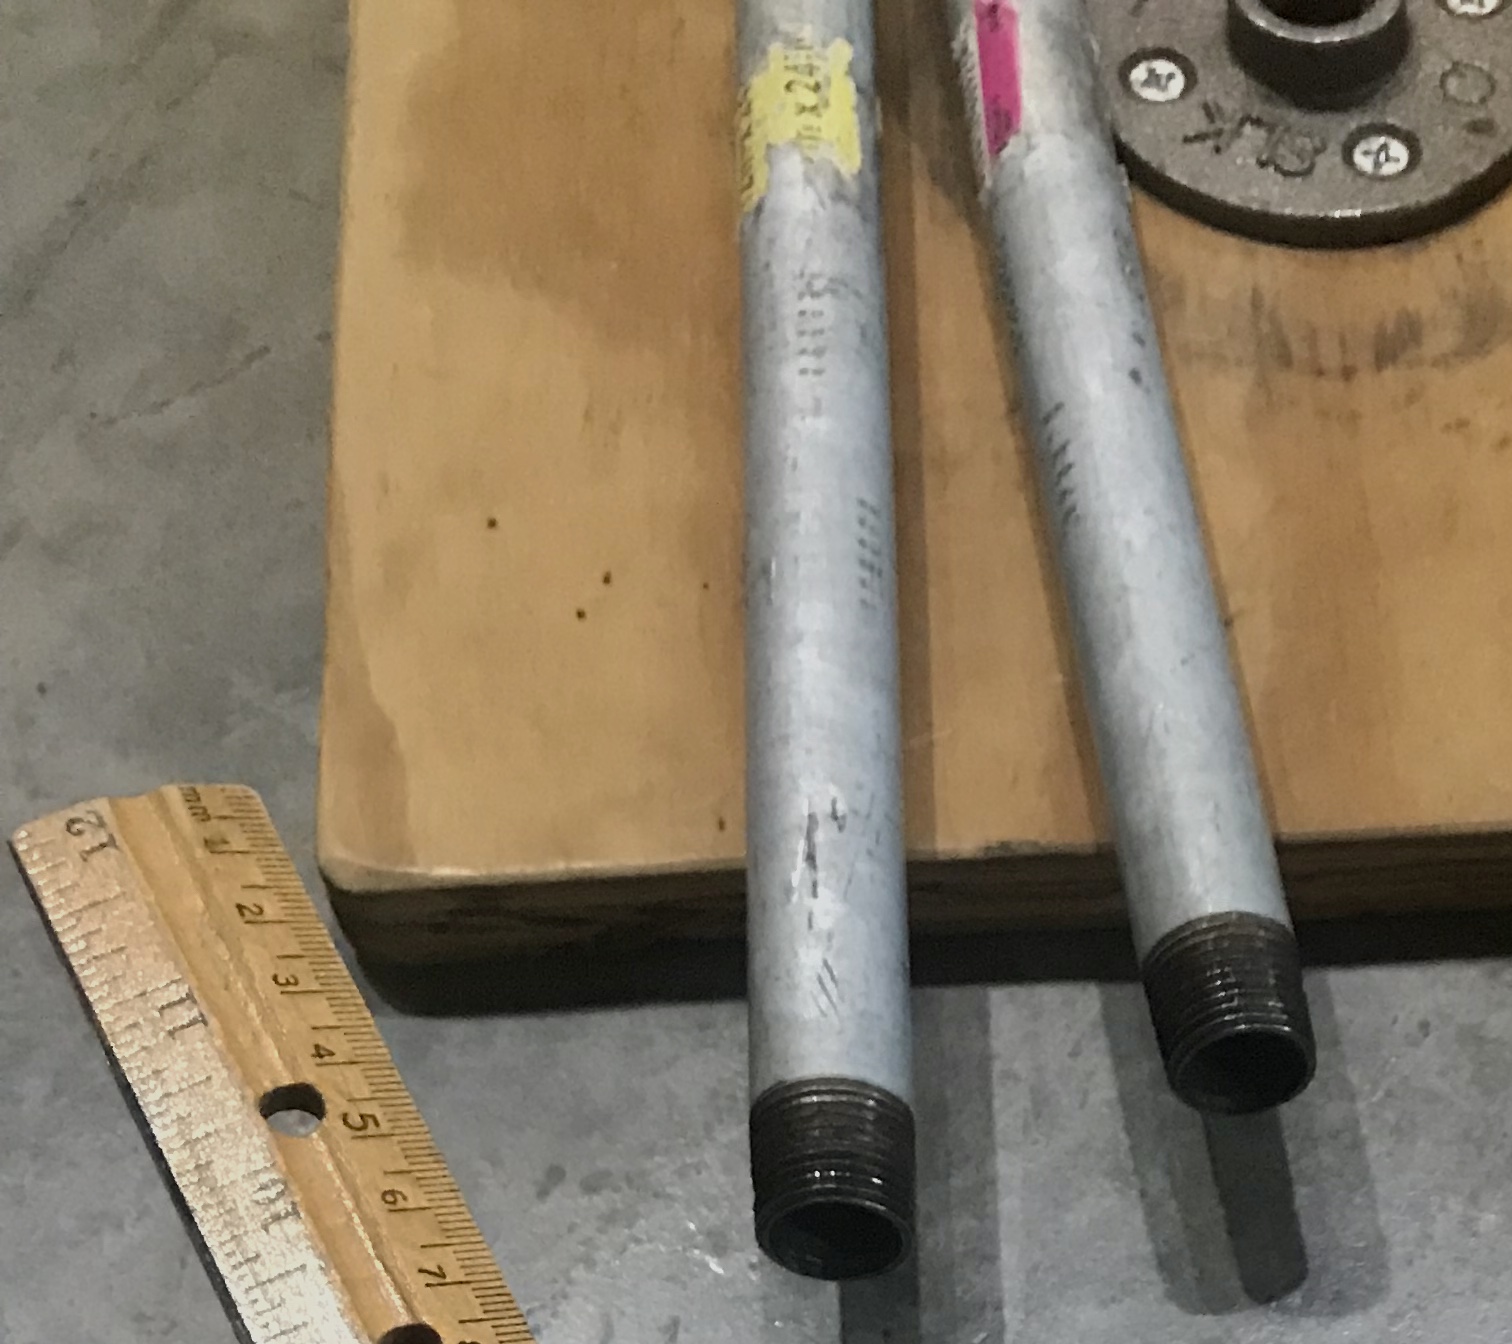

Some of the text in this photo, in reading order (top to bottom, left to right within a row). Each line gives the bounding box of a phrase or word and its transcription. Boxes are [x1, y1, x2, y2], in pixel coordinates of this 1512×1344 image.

[66, 810, 119, 862] 12
[158, 992, 208, 1041] 11
[182, 786, 211, 822] mm
[235, 902, 265, 919] 2
[271, 973, 299, 988] 3
[310, 1043, 335, 1060] 4
[342, 1111, 380, 1132] 5
[381, 1188, 408, 1206] 6
[418, 1264, 447, 1281] 7
